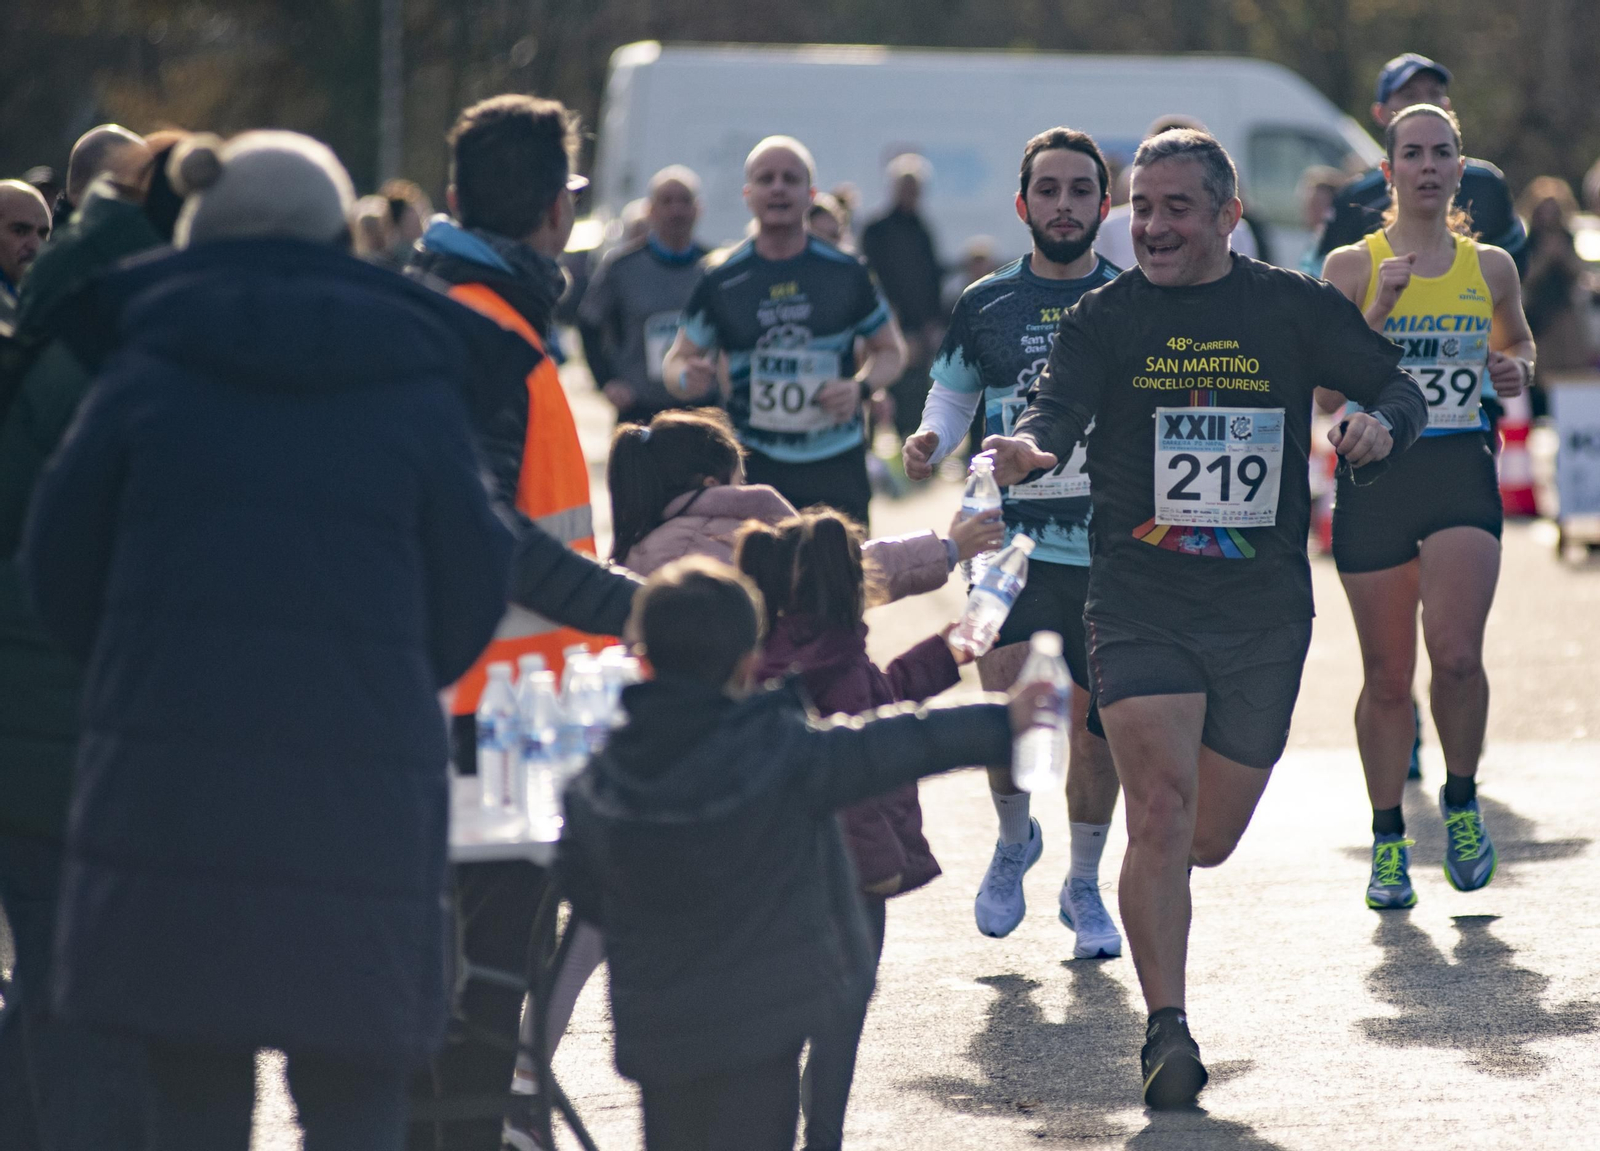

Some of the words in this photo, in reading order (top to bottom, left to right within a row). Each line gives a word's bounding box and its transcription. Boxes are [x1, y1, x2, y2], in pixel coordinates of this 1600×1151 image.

[1020, 335, 1045, 345] San
[1193, 340, 1240, 352] CARREIRA
[1145, 356, 1179, 374] SAN
[1182, 355, 1260, 374] MARTIÑO
[1132, 376, 1195, 390] CONCELLO
[1197, 377, 1214, 388] DE
[1216, 377, 1270, 392] OURENSE
[1402, 368, 1478, 407] 39
[1163, 415, 1226, 441] XXII
[1166, 453, 1268, 502] 219
